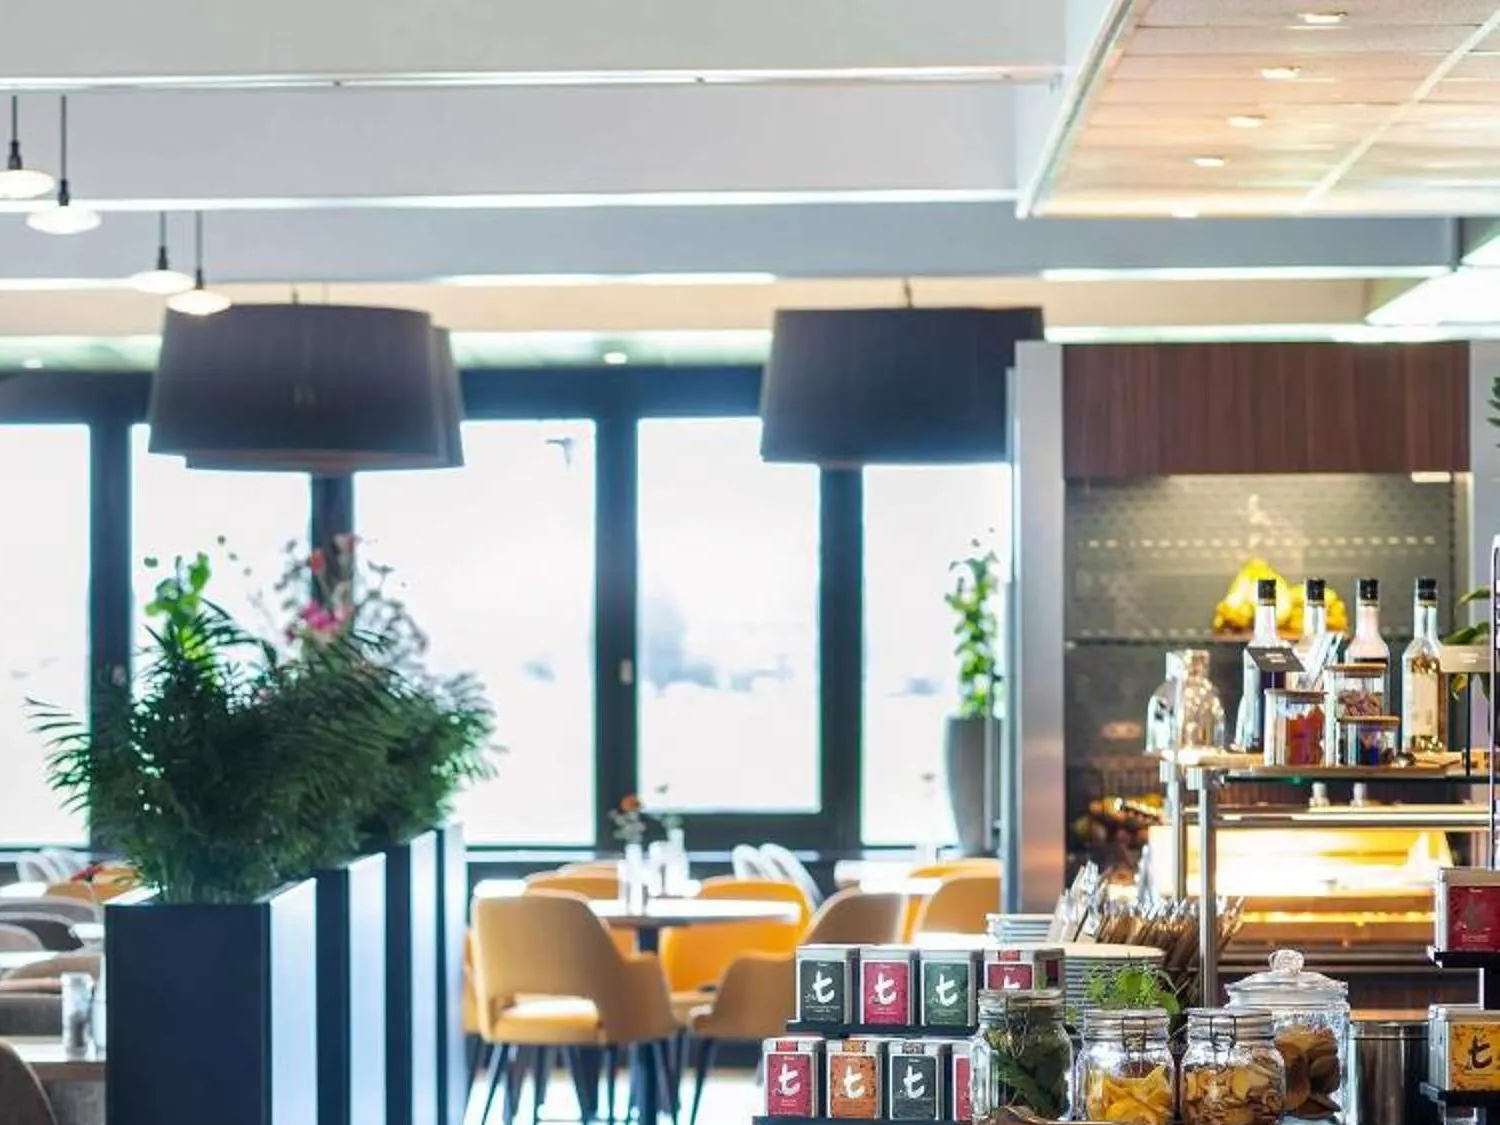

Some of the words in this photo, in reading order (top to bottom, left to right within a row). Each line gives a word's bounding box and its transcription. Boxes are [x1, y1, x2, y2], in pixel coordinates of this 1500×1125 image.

[812, 970, 835, 1004] t
[874, 972, 897, 1005] t
[935, 973, 958, 1007] t
[1468, 1035, 1493, 1069] t
[778, 1063, 800, 1096] t
[843, 1065, 866, 1099] t
[903, 1065, 925, 1099] t
